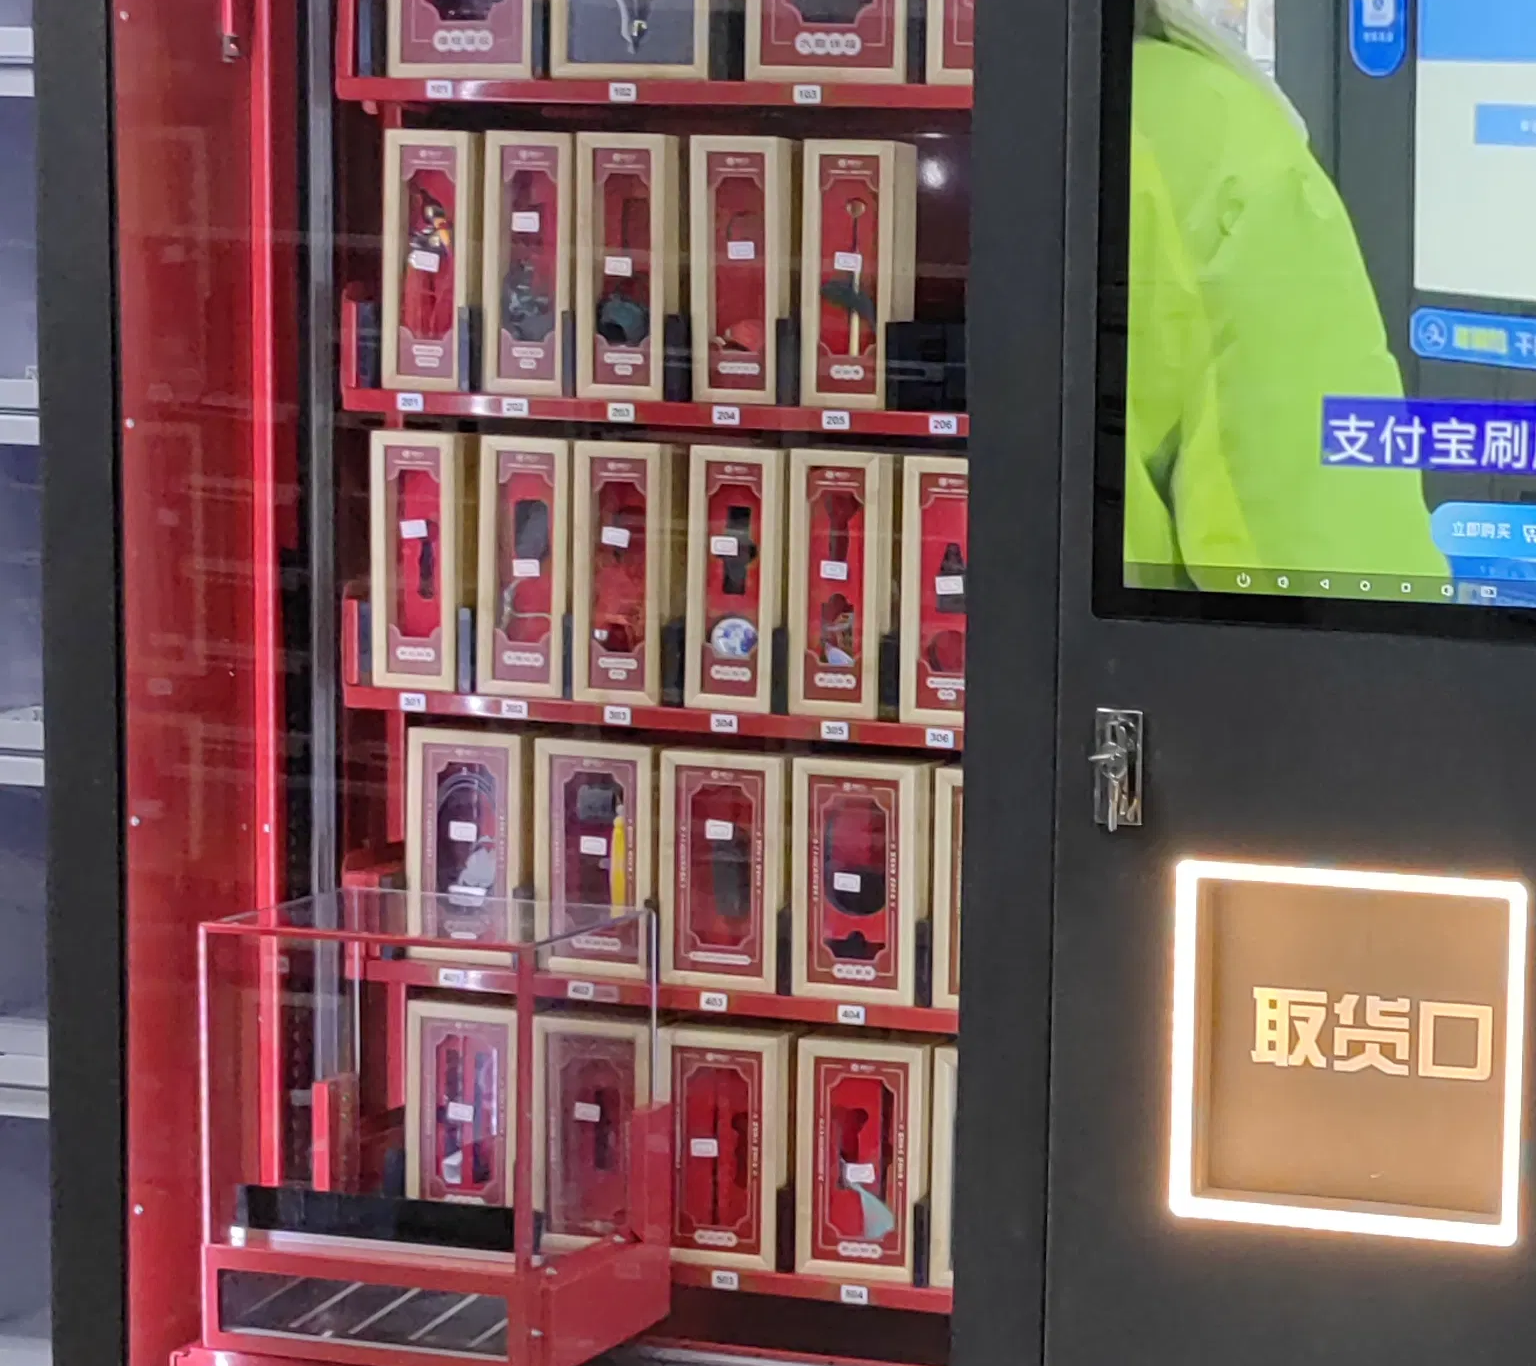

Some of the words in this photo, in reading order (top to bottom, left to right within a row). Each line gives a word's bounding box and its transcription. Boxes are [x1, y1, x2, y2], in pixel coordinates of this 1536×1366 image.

[799, 89, 817, 99] 103
[717, 411, 736, 420] 204
[826, 415, 846, 425] 205
[933, 419, 953, 430] 206
[1451, 520, 1512, 540] 立即购买
[715, 718, 733, 728] 304
[826, 725, 845, 736] 305
[930, 732, 949, 743] 306
[842, 1010, 861, 1019] 404
[1250, 985, 1495, 1082] 取货口
